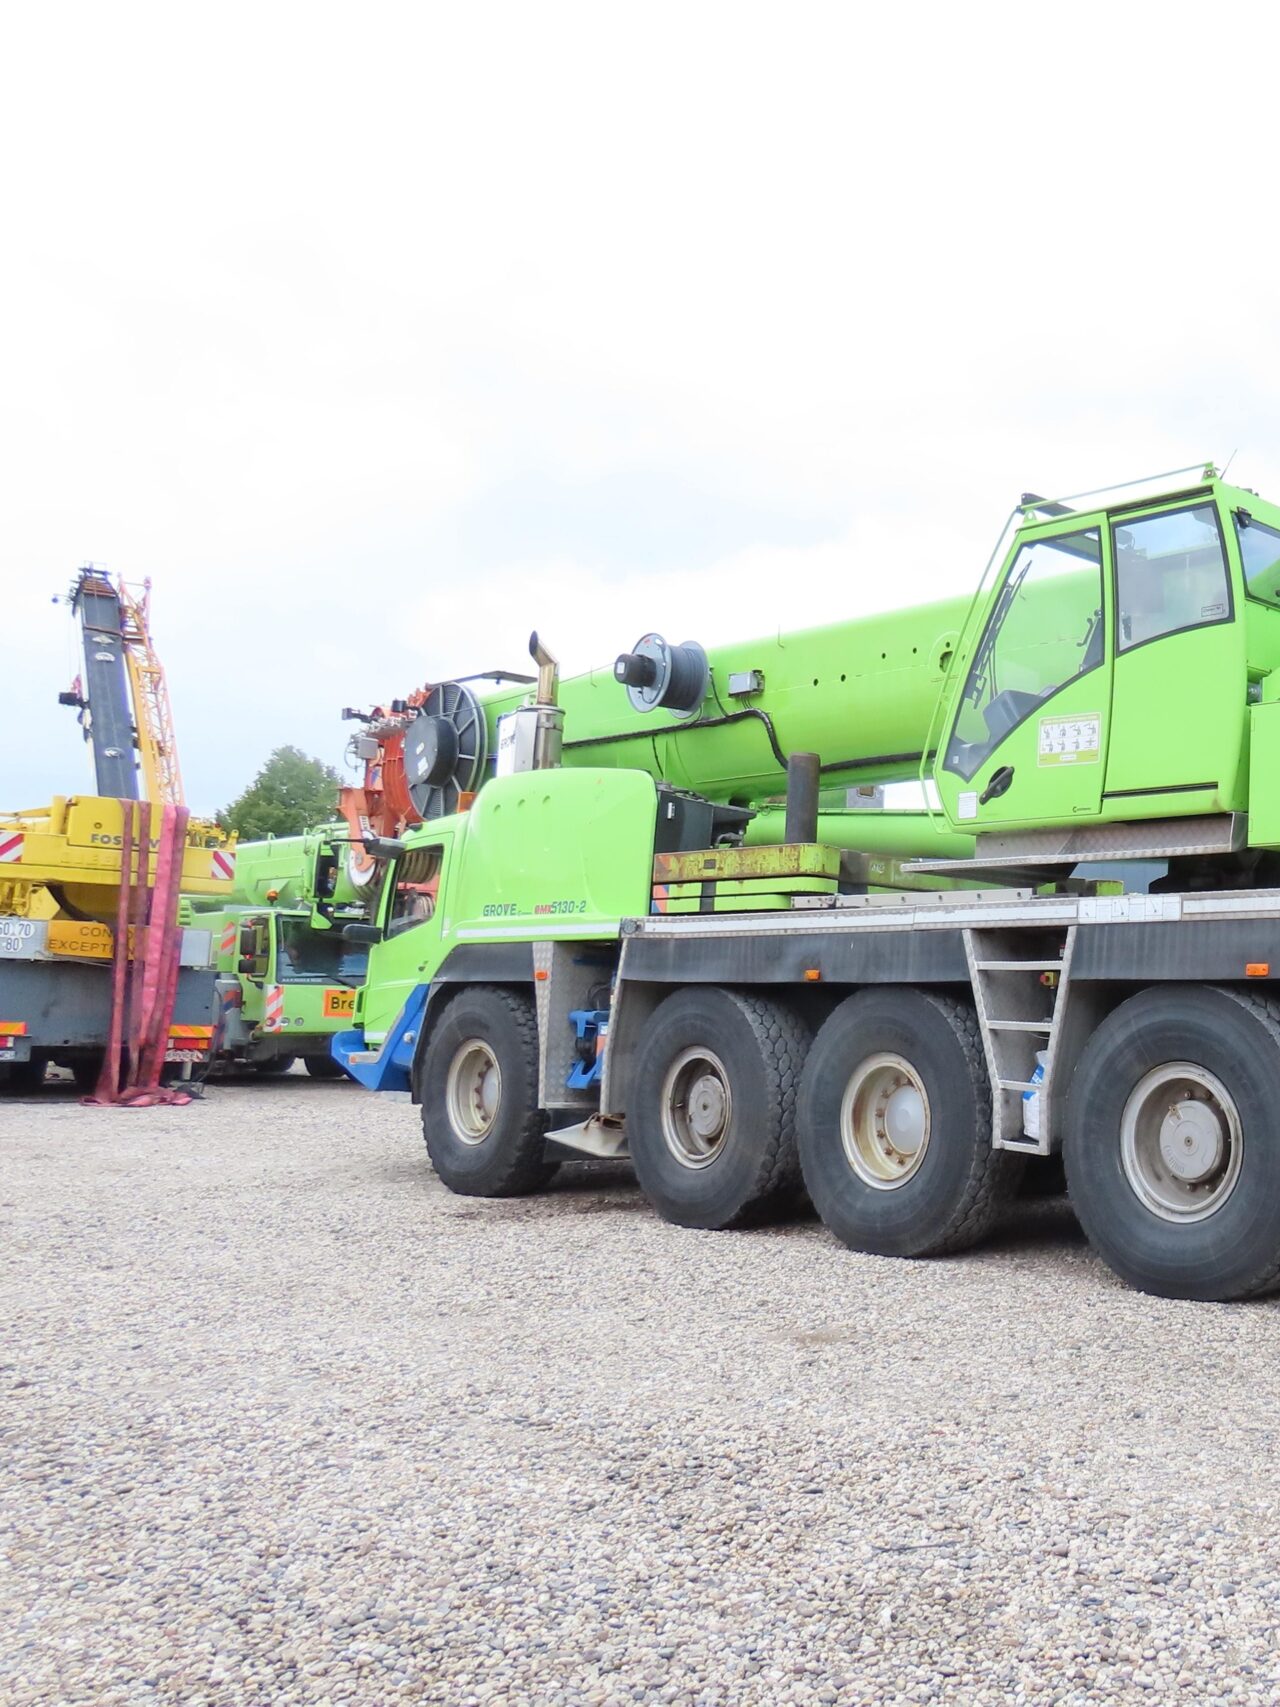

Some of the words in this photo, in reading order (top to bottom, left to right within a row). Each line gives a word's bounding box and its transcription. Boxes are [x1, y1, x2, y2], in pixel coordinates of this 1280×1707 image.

[483, 903, 517, 916] GROVE
[550, 900, 586, 914] 5130-2
[18, 923, 31, 937] 70
[5, 937, 20, 951] 80
